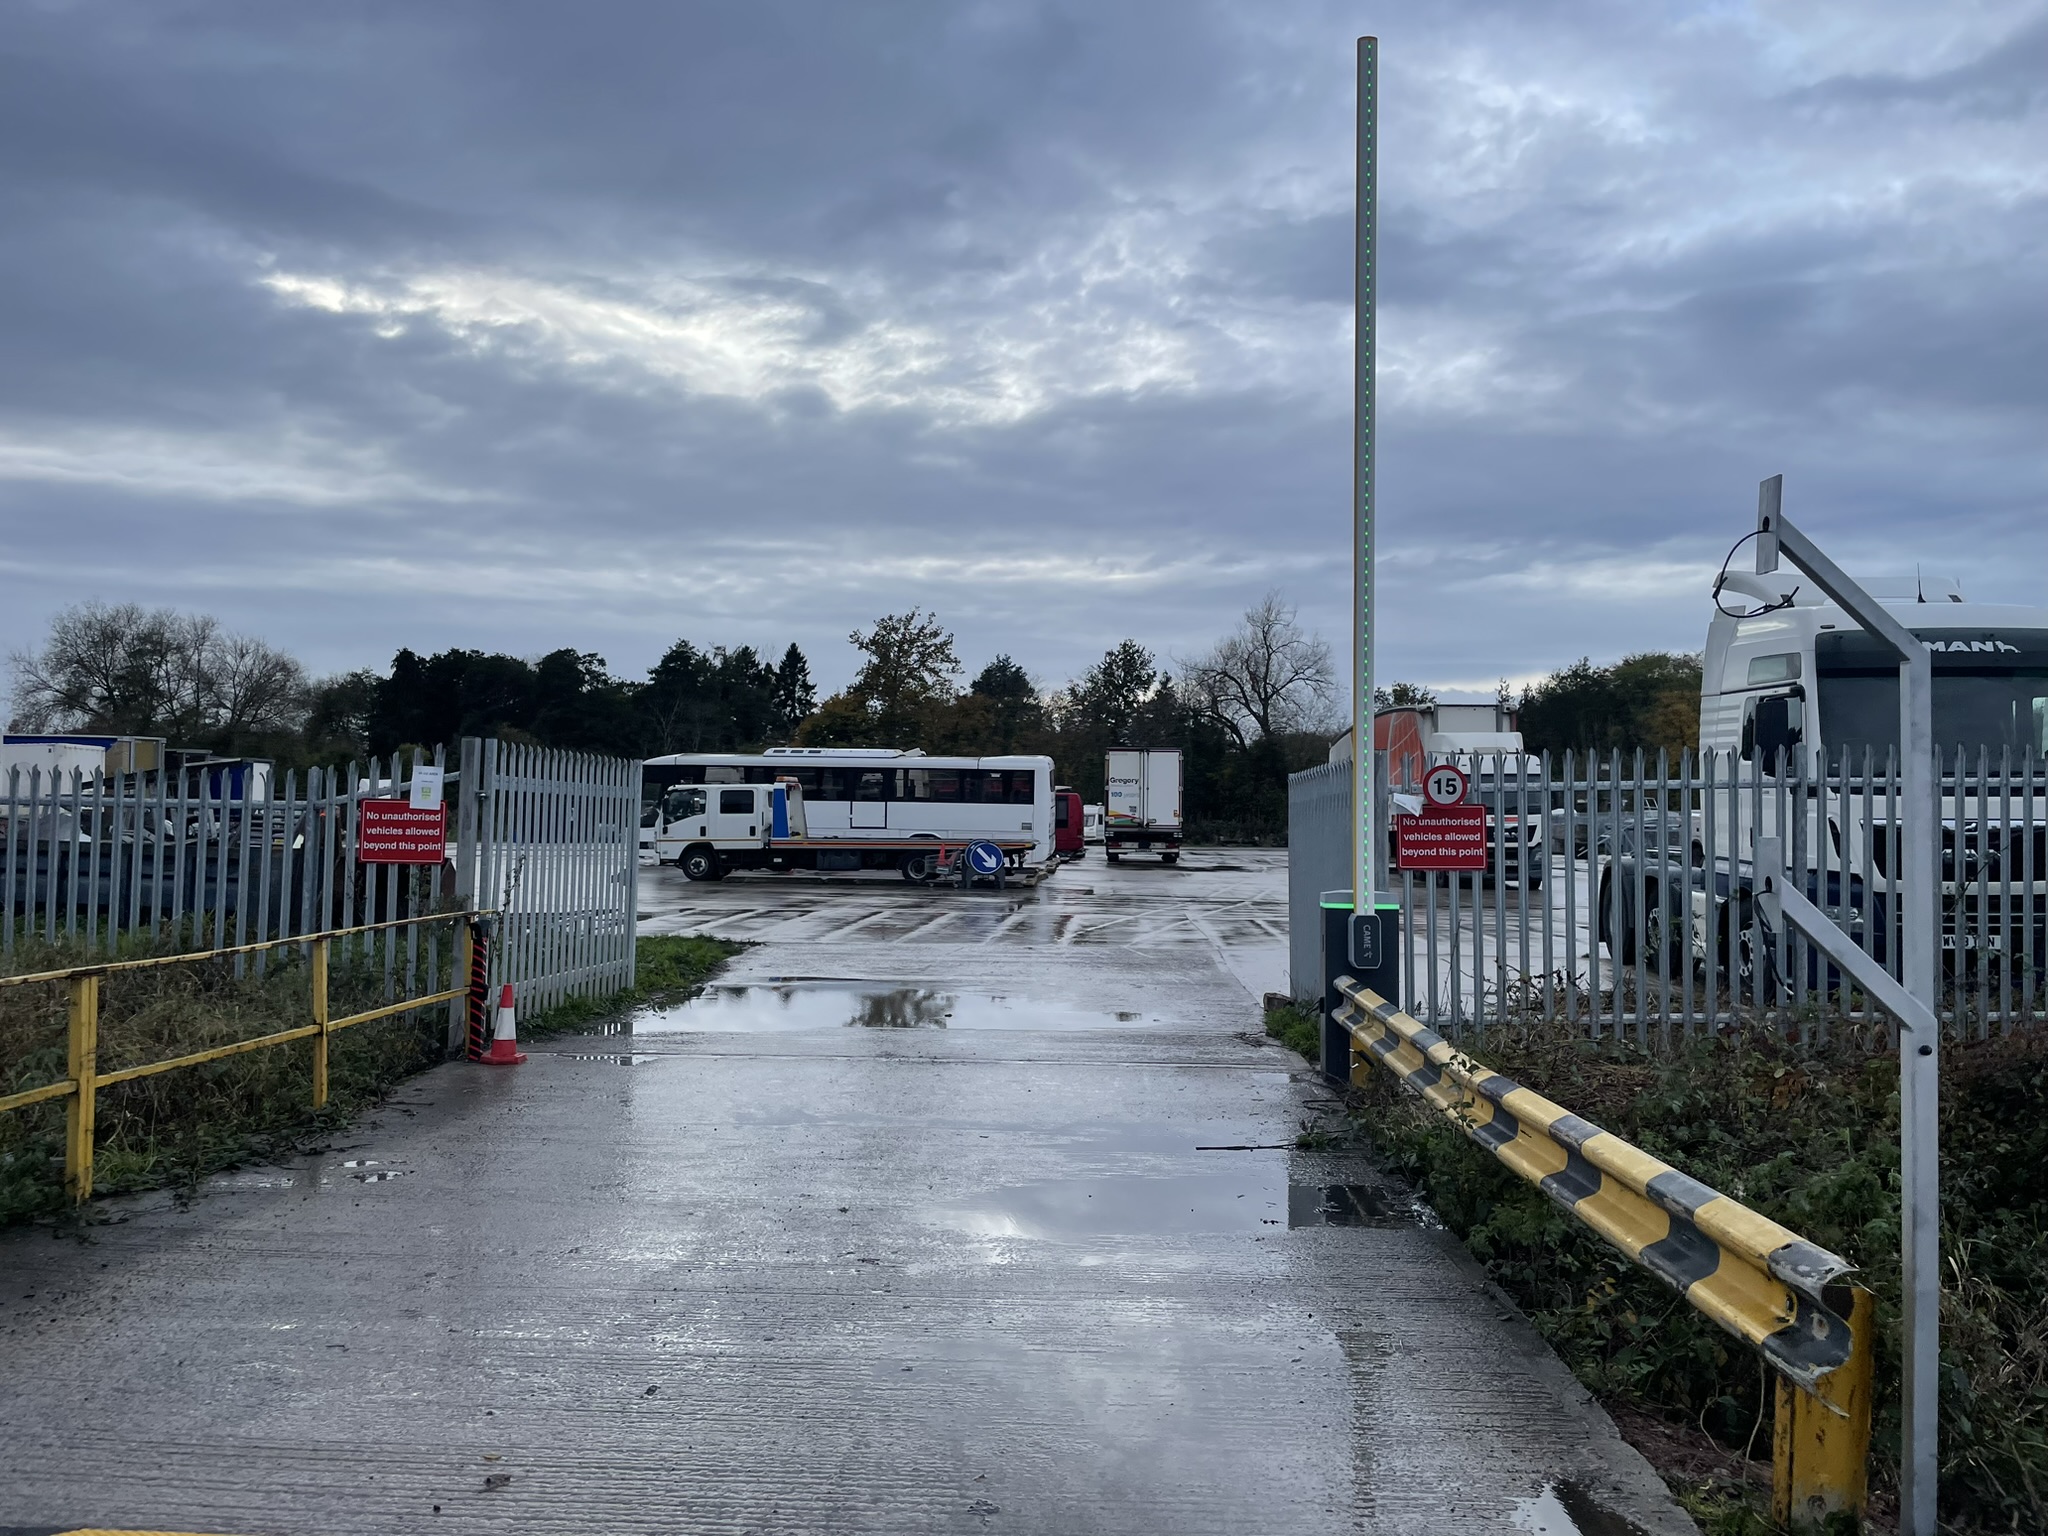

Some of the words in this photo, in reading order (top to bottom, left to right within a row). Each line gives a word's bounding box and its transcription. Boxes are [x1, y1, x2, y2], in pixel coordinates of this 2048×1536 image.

[1921, 641, 1995, 652] MAN
[1110, 777, 1139, 785] Gregory
[1433, 777, 1457, 796] 15
[366, 811, 380, 820] No
[381, 812, 441, 821] unauthorised
[1402, 817, 1417, 826] No
[1418, 817, 1481, 826] unauthorised
[366, 826, 403, 835] vehicles
[405, 827, 440, 836] allowed
[1403, 832, 1443, 841] vehicles
[1444, 832, 1481, 841] allowed
[363, 841, 397, 851] beyond
[398, 841, 416, 850] this
[417, 842, 442, 852] point
[1402, 847, 1437, 858] beyond
[1438, 847, 1457, 856] this
[1458, 847, 1484, 858] point
[1363, 924, 1372, 949] CAME
